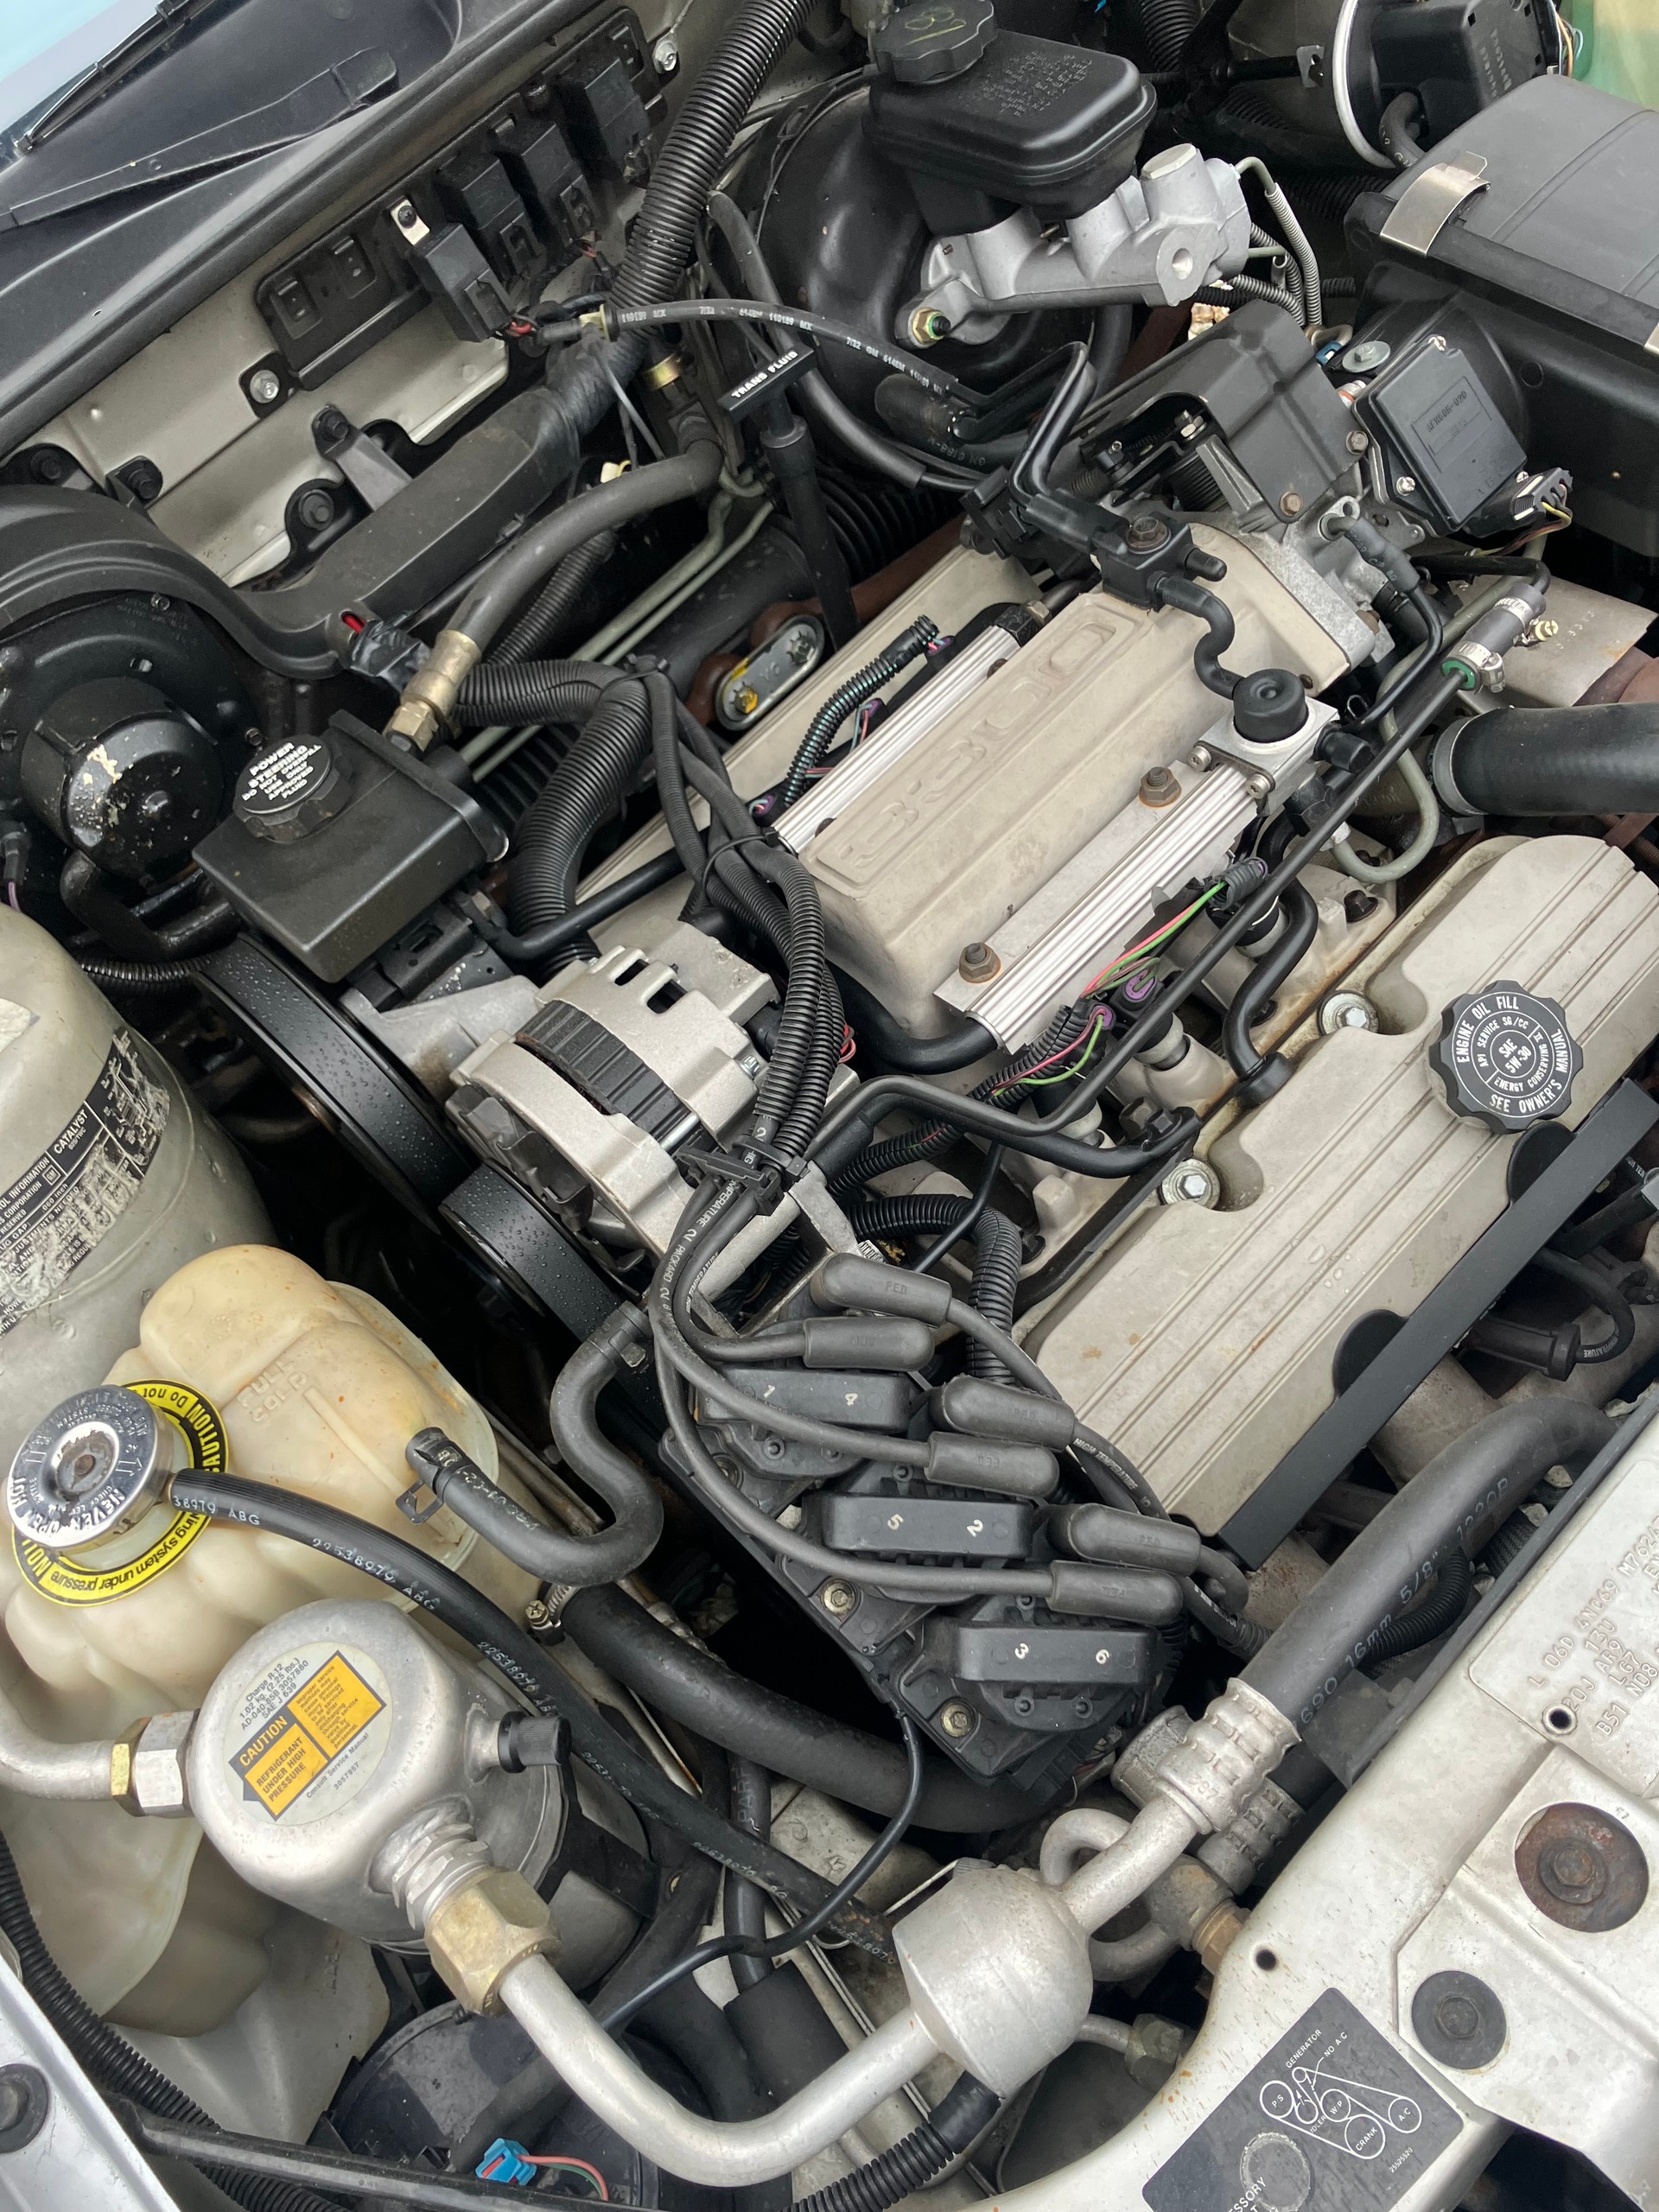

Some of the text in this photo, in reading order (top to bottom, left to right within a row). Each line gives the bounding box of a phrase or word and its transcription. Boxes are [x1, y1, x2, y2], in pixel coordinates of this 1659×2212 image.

[730, 350, 798, 399] TRANS FLUID
[249, 742, 294, 776] POWER
[838, 621, 1117, 870] 3800
[242, 744, 321, 801] DO NOT OVERFILL
[248, 745, 308, 788] STEERING
[264, 761, 307, 794] USE ONLY
[268, 766, 314, 800] APPROVED
[282, 779, 308, 798] FLUID
[1456, 995, 1519, 1064] ENGINE OIL FILL
[1477, 1020, 1500, 1048] SERVICE
[1477, 1053, 1489, 1068] API
[1498, 1038, 1518, 1058] SAE
[1504, 1046, 1532, 1074] 5W-30
[1489, 1028, 1568, 1114] SEE OWNER'S MANUAL
[1494, 1077, 1524, 1092] ENERGY
[1527, 1043, 1549, 1089] CONSERVING
[54, 1109, 88, 1154] CATALYST
[9, 1156, 50, 1199] INFORMATION
[54, 1183, 68, 1198] inch
[4, 1180, 42, 1220] CORPORATION
[1, 1211, 27, 1234] RESERVED
[663, 1244, 686, 1282] PACKARD
[143, 1387, 166, 1399] not
[170, 1391, 189, 1409] Do
[236, 1361, 295, 1408] FULL
[251, 1371, 308, 1422] COLD
[763, 1384, 776, 1399] 1
[844, 1392, 859, 1407] 4
[1071, 1437, 1139, 1491] HIGH TEMPERATURE
[69, 1488, 125, 1531] NEVER
[88, 1485, 113, 1507] CHECK
[173, 1495, 216, 1514] 38979
[228, 1506, 260, 1526] ABG
[887, 1513, 905, 1530] 5
[966, 1518, 984, 1539] 2
[50, 1538, 179, 1593] system under pressure
[1573, 1578, 1620, 1631] 4NC69
[1344, 1613, 1392, 1669] 16mm
[1584, 1617, 1618, 1652] 13U
[1014, 1643, 1030, 1661] 3
[1095, 1649, 1110, 1665] 6
[1593, 1638, 1624, 1674] AR9
[239, 1700, 256, 1719] 1.02
[266, 1672, 285, 1693] (2.25
[284, 1656, 302, 1674] lbs.)
[245, 1662, 284, 1703] Charge R-12
[296, 1665, 335, 1705] Improper service
[299, 1677, 332, 1708] methods may
[303, 1677, 339, 1713] cause personal
[322, 1683, 342, 1702] Fittings
[324, 1688, 345, 1708] serviced
[261, 1701, 278, 1719] SAE
[284, 1682, 298, 1699] 639
[315, 1702, 338, 1727] only after
[319, 1703, 346, 1731] discharging
[322, 1697, 359, 1735] through service
[327, 1725, 340, 1738] valve
[330, 1721, 350, 1744] qualified
[1596, 1700, 1630, 1738] B51
[238, 1715, 289, 1767] CAUTION
[256, 1737, 303, 1787] REFRIGERANT
[262, 1749, 307, 1795] UNDER HIGH
[306, 1732, 370, 1798] Consult Service Manual
[334, 1761, 359, 1790] 3057957
[268, 1762, 307, 1802] PRESSURE
[1285, 2029, 1322, 2069] GENERATOR
[1323, 2031, 1349, 2058] NO A/C
[1271, 2094, 1285, 2108] P/S
[1330, 2101, 1344, 2116] W/P
[1398, 2107, 1412, 2123] A/C
[1309, 2114, 1327, 2134] IDLER
[1355, 2126, 1379, 2152] CRANK
[1389, 2146, 1414, 2174] 25525520
[1229, 2177, 1267, 2212] SSORY
